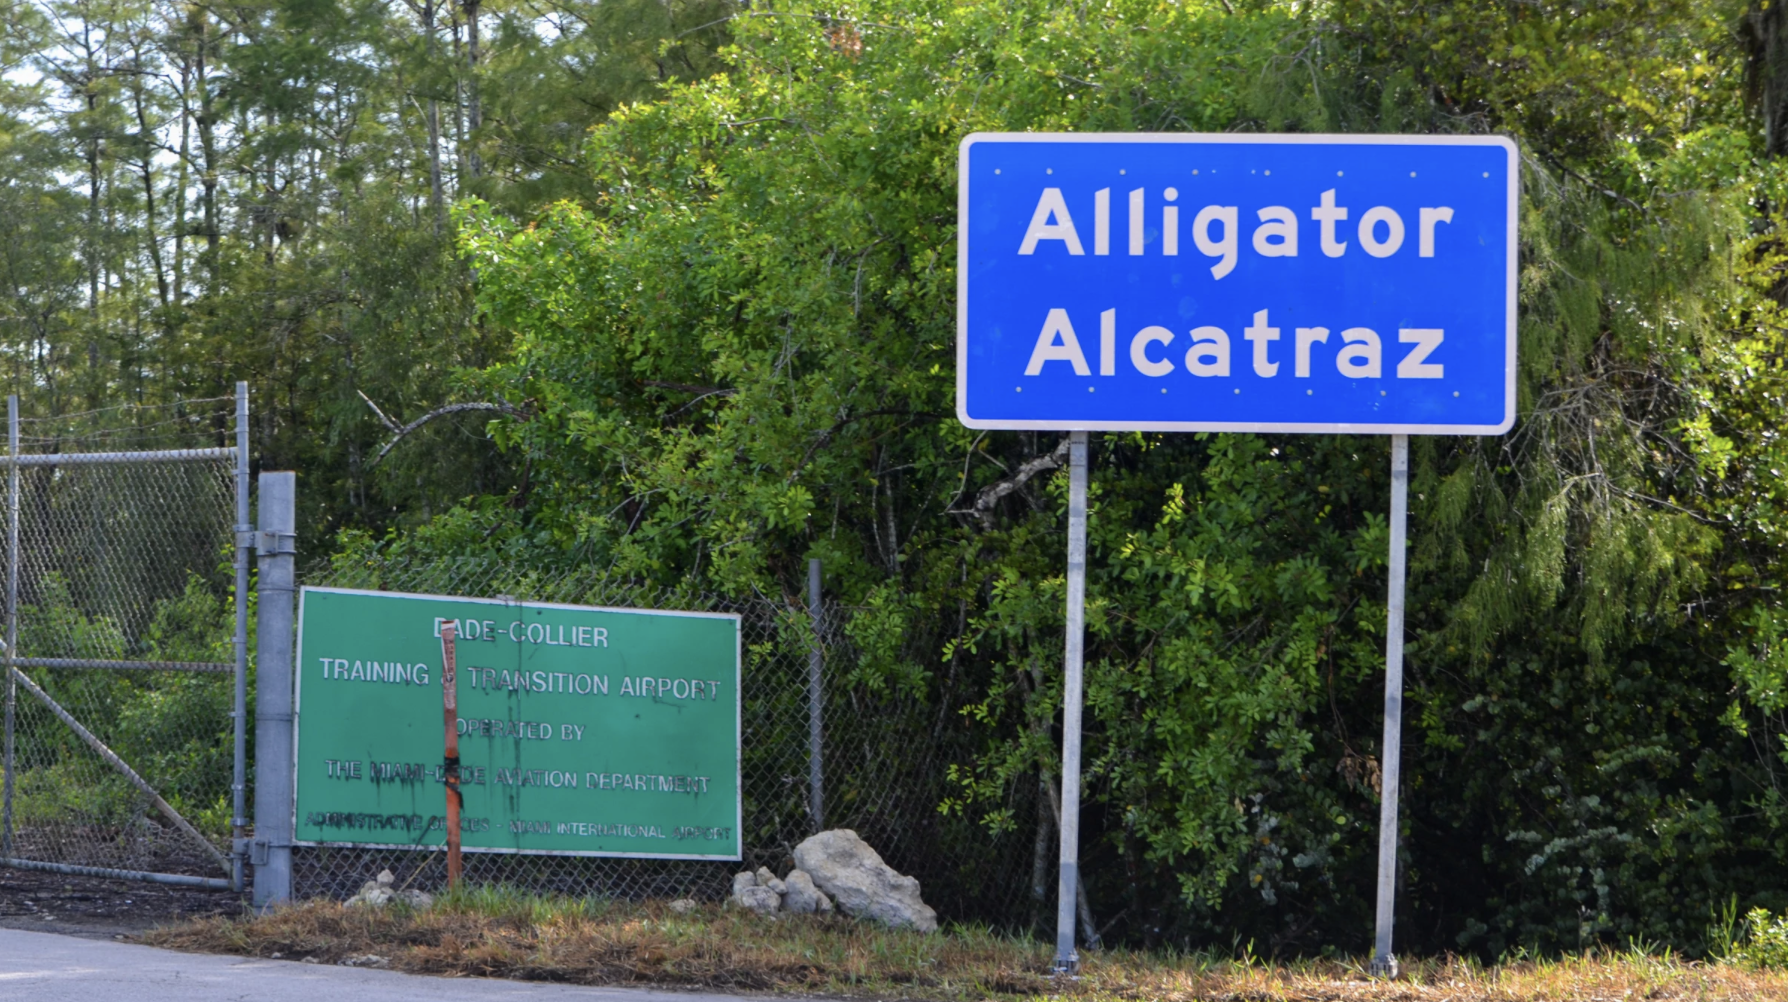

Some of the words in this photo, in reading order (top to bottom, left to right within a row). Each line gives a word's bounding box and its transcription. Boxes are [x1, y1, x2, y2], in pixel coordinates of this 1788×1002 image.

[1017, 187, 1455, 281] Alligator
[1024, 308, 1445, 379] Alcatraz
[319, 658, 429, 685] TRAINING
[467, 667, 608, 696] TRANSITION
[620, 676, 720, 699] AIRPORT
[455, 718, 552, 740] OPERATED
[561, 724, 586, 741] BY
[325, 760, 362, 779] THE
[370, 762, 486, 785] MIAMI-DDE
[494, 767, 577, 788] AVIATION
[586, 772, 710, 793] DEPARTMENT
[429, 815, 489, 831] OFCES
[510, 820, 550, 834] MIAMI
[557, 822, 665, 839] INTERNATIONAL
[672, 826, 731, 840] AIRPORT
